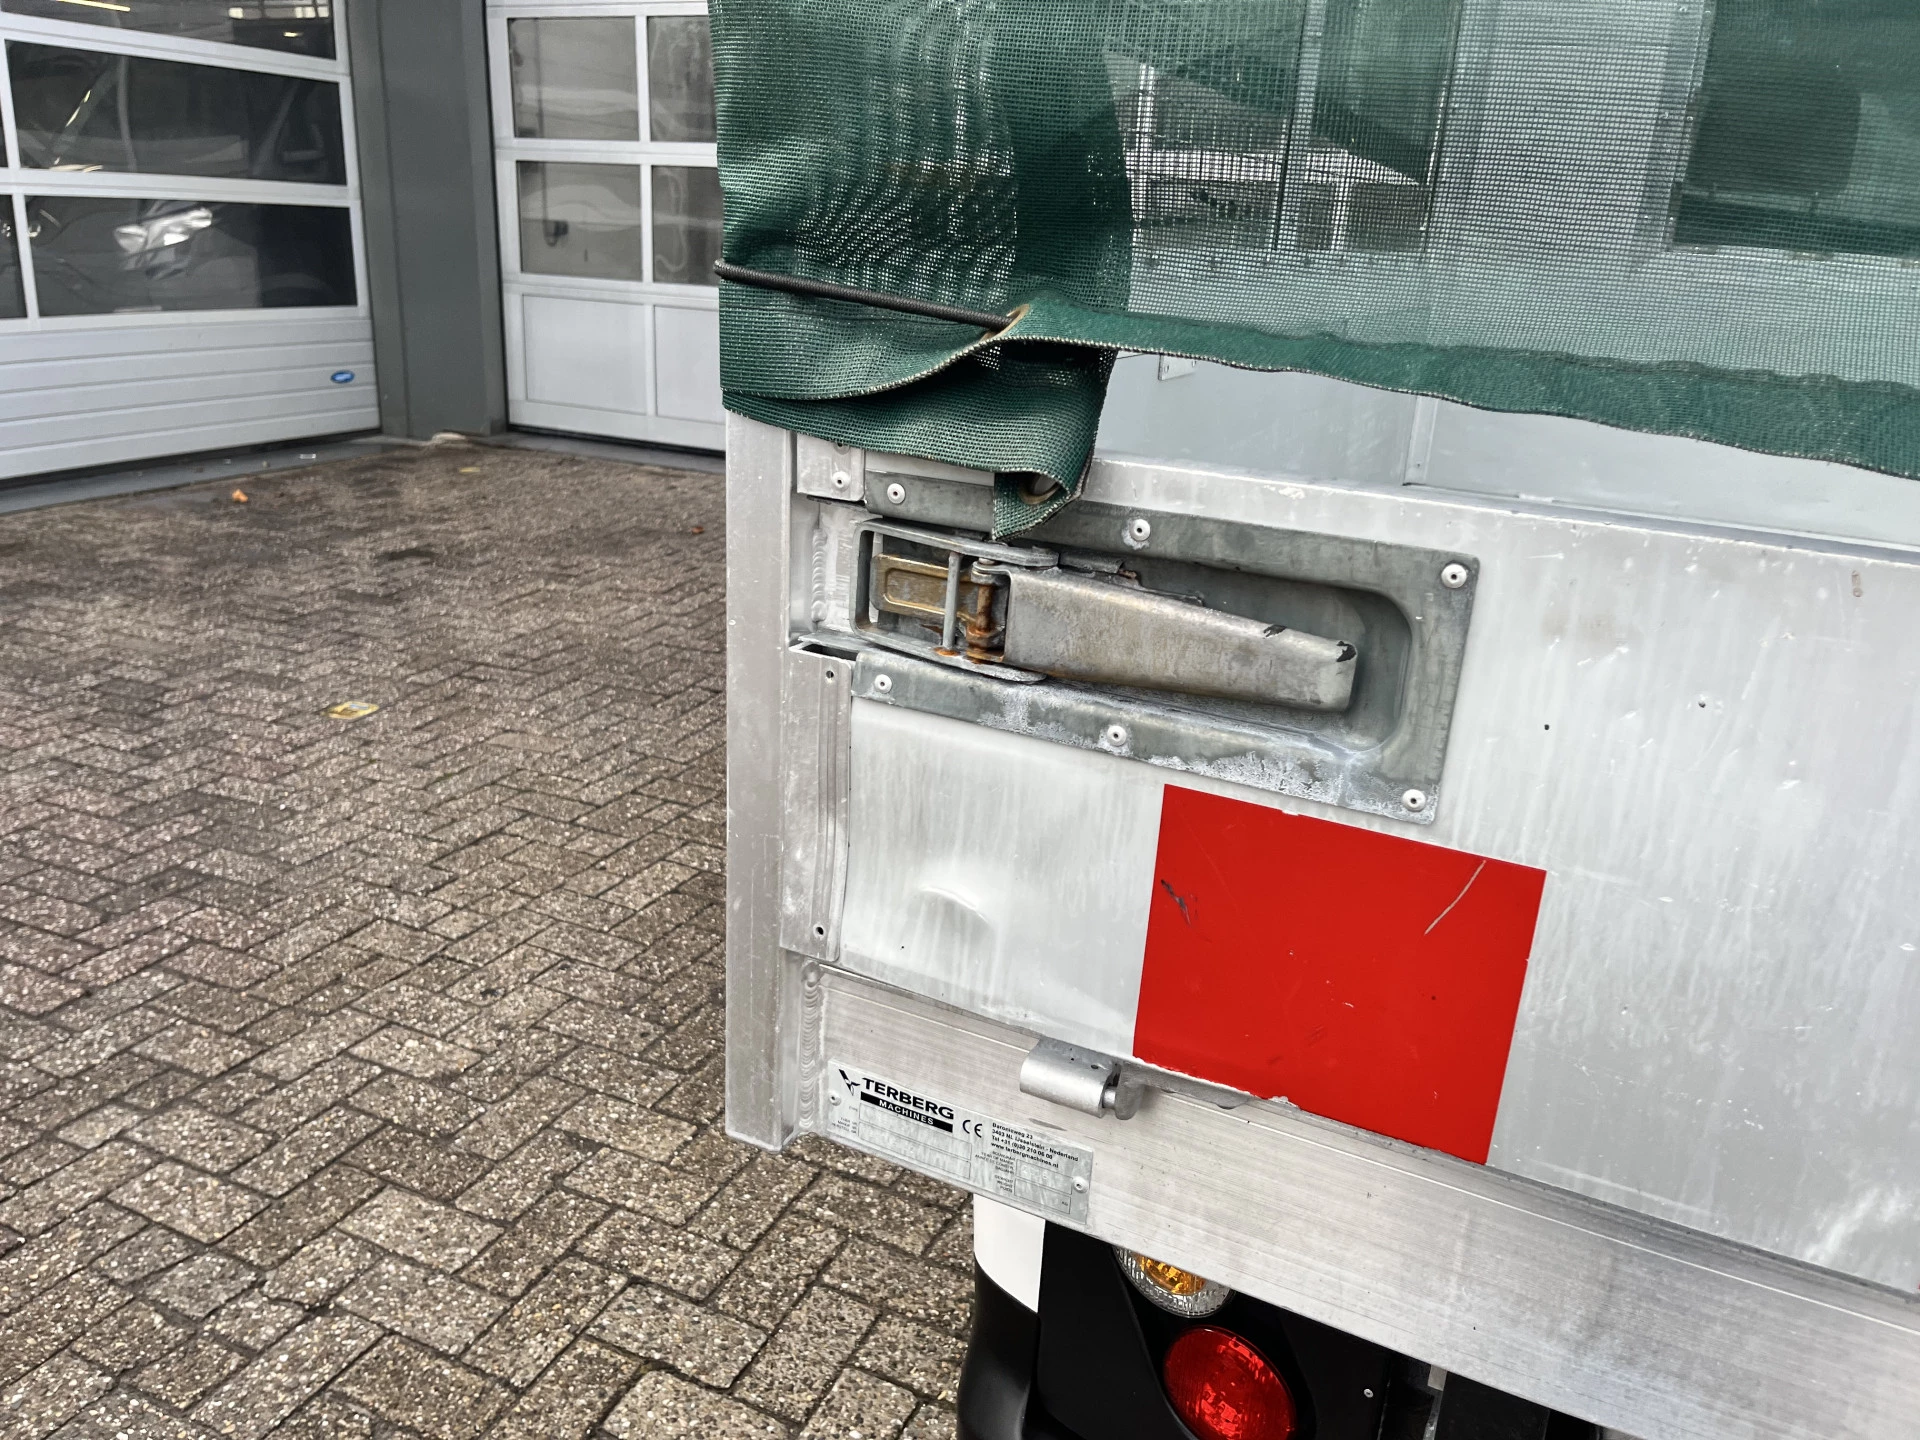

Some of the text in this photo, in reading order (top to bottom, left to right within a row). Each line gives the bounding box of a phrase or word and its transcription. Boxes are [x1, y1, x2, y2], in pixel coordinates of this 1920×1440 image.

[862, 1077, 954, 1120] TERBERG
[879, 1100, 934, 1125] MACHINES
[962, 1119, 983, 1138] CE
[1049, 1147, 1079, 1162] Nederland
